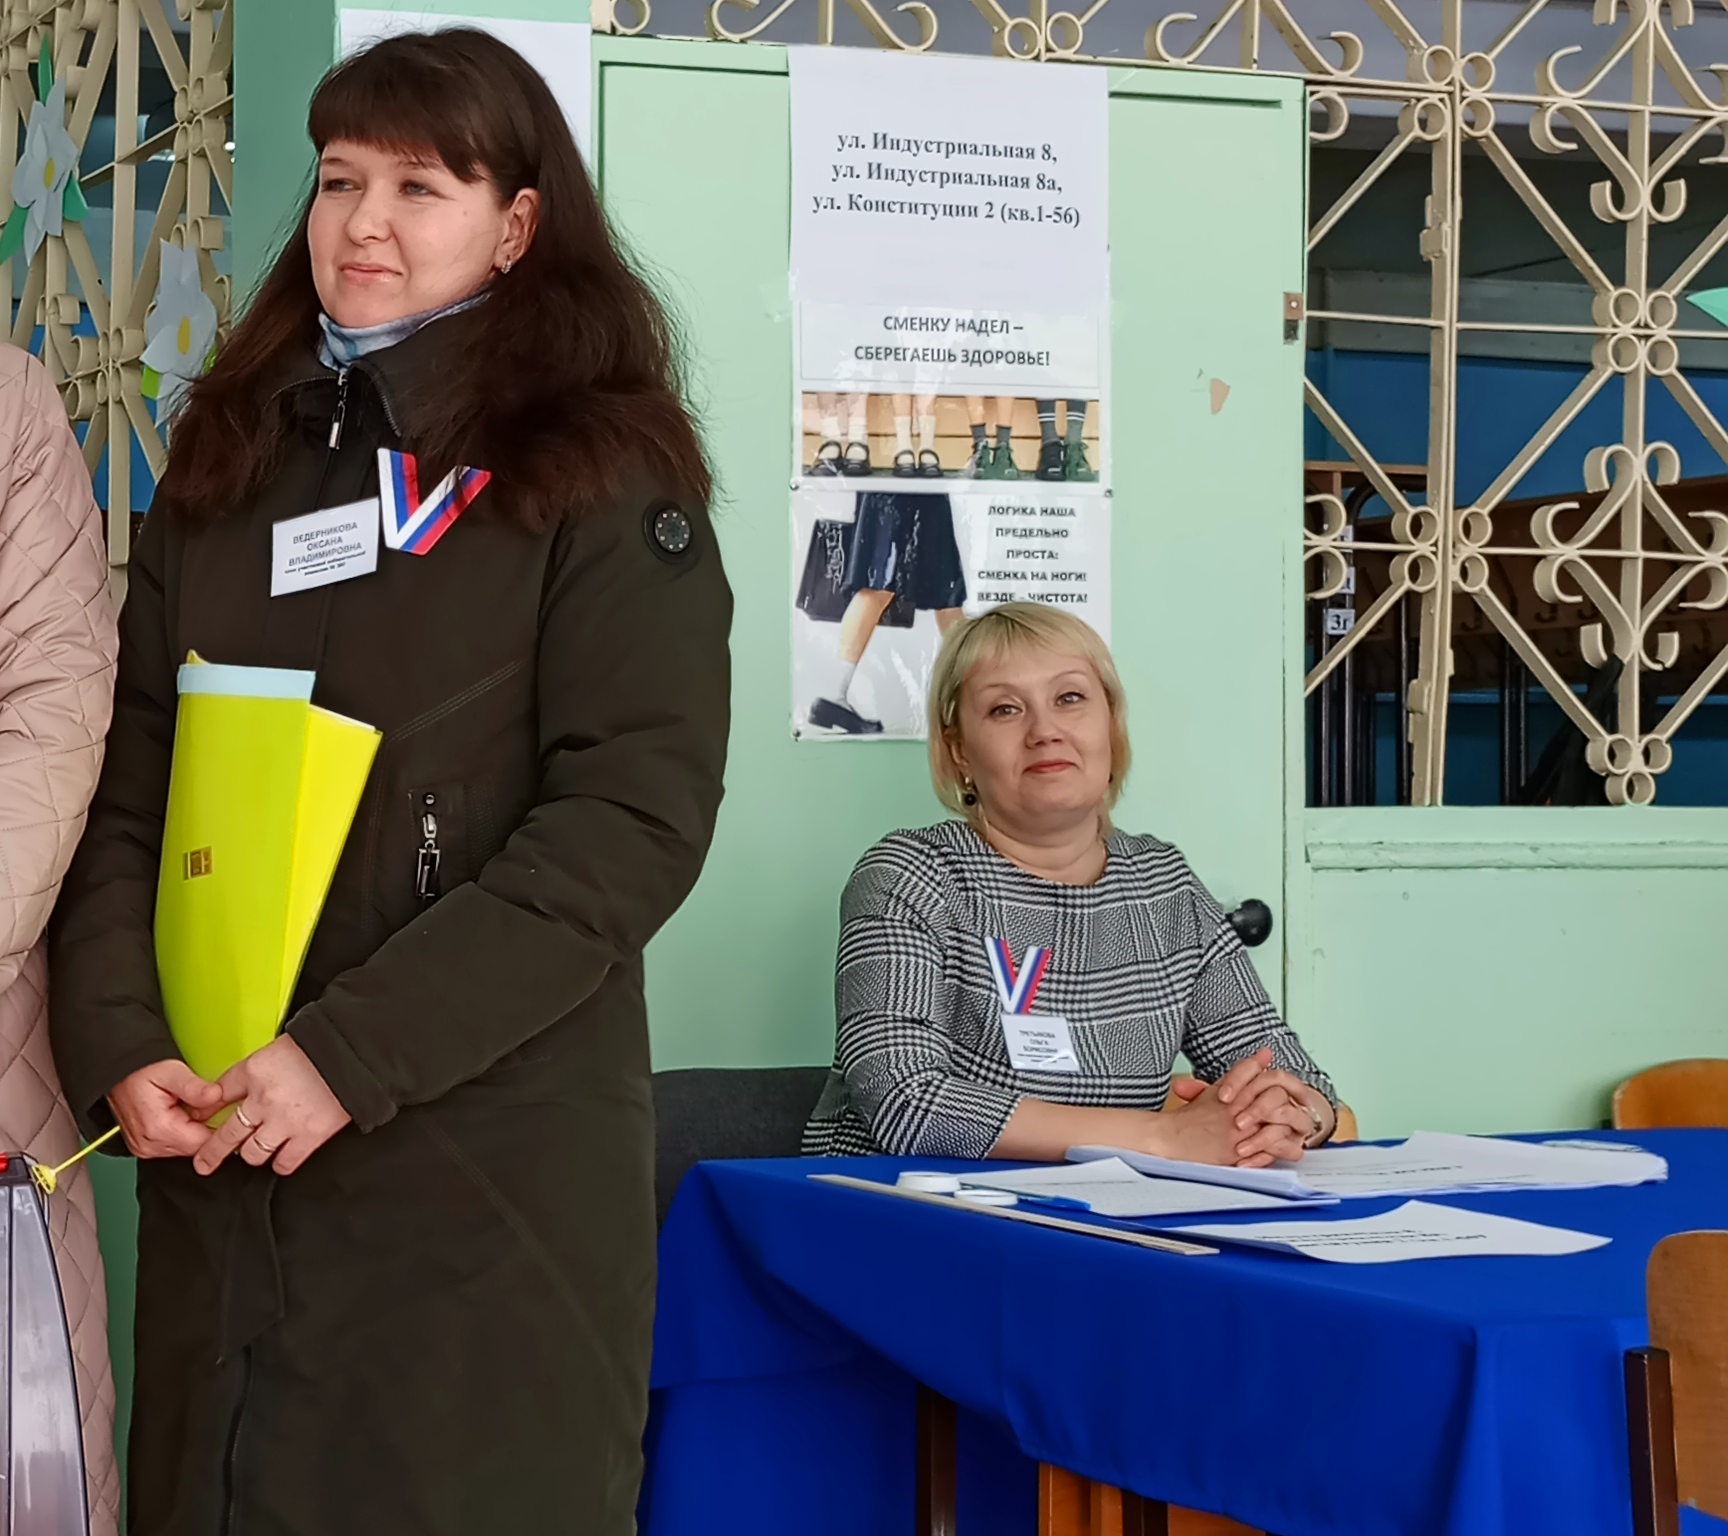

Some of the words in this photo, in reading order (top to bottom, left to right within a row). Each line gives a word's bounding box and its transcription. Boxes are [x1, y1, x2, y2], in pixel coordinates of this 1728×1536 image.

[837, 134, 866, 152] ул.
[872, 132, 1035, 160] Индустриальная
[1041, 144, 1057, 165] 8,
[832, 164, 860, 182] ул.
[867, 162, 1030, 190] Индустриальная
[1036, 173, 1062, 195] 8а,
[812, 195, 841, 214] ул.
[848, 193, 978, 221] Конституции
[984, 201, 994, 218] 2
[1000, 203, 1080, 229] (кв.1-56)
[883, 316, 950, 333] СМЕНКУ
[955, 318, 1009, 337] НАДЕЛ
[854, 345, 957, 363] СБЕРЕГАЕШЬ
[961, 349, 1050, 367] ЗДОРОВЬЕ!
[988, 505, 1037, 516] ЛОГИКА
[1040, 506, 1076, 517] НАША
[292, 521, 359, 545] ВЕДЕРНИКОВА
[306, 535, 343, 552] ОКСАНА
[995, 527, 1069, 539] ПРЕДЕЛЬНО
[288, 542, 362, 567] ВЛАДИМИРОВНА
[1006, 549, 1059, 560] ПРОСТА:
[977, 570, 1028, 581] СМЕНКА
[1031, 571, 1048, 581] НА
[1051, 572, 1087, 582] НОГИ!
[977, 592, 1016, 603] ВЕЗДЕ
[1028, 592, 1088, 604] ЧИСТОТА!
